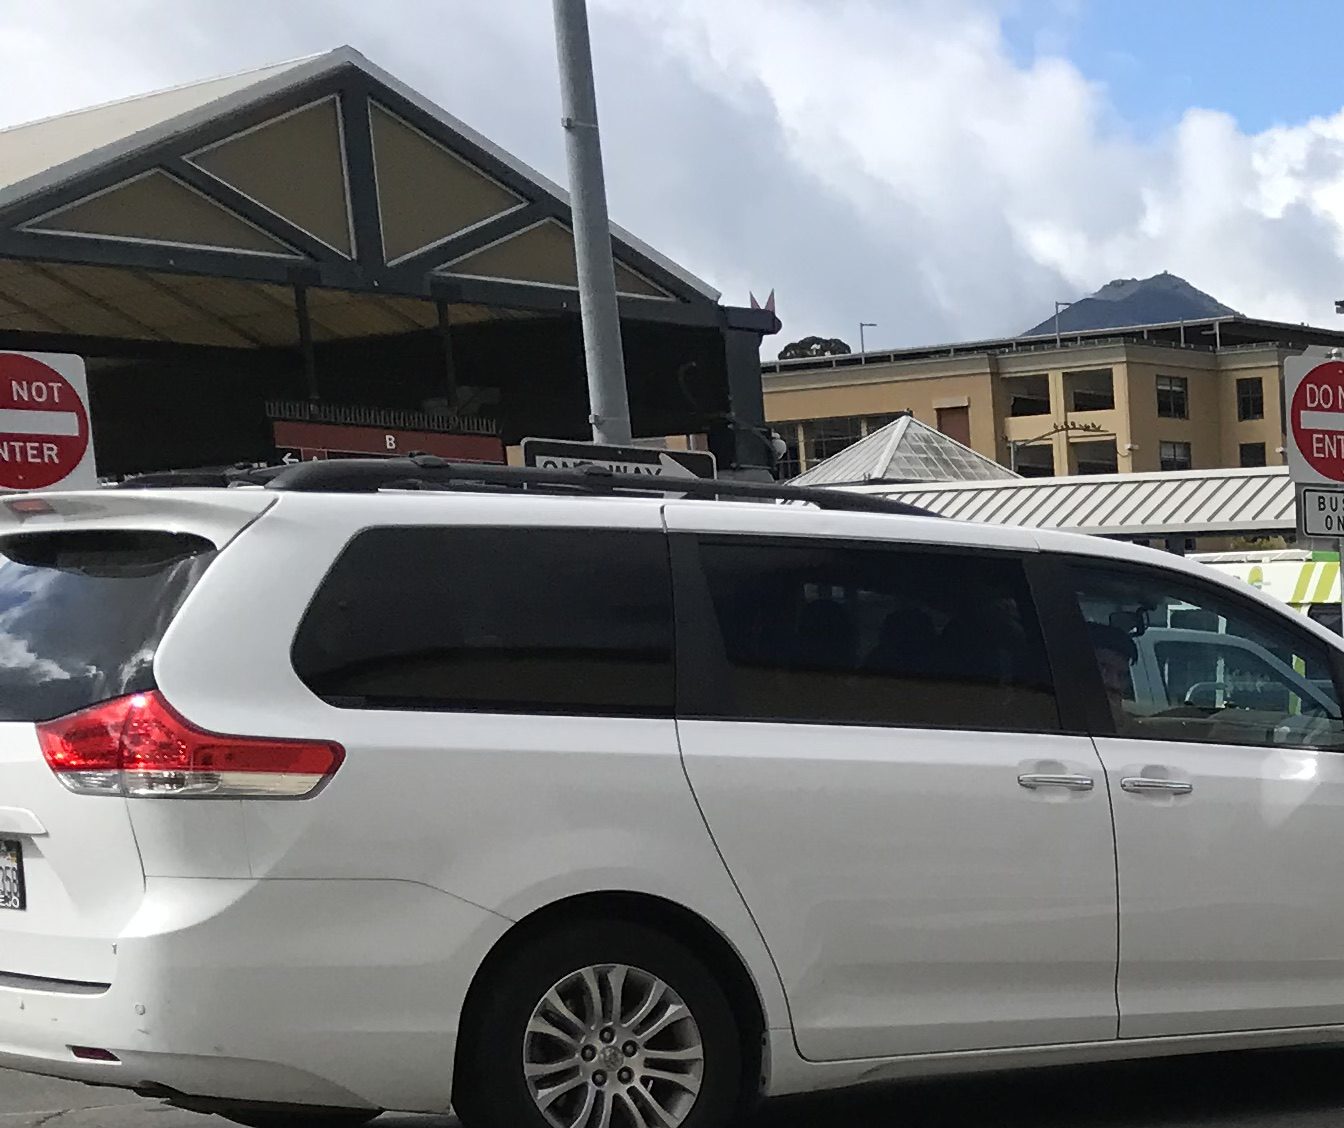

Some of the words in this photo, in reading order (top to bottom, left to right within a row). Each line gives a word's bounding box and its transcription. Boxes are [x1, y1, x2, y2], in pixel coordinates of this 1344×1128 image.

[11, 380, 62, 402] NOT
[1306, 383, 1333, 409] DO
[0, 441, 59, 463] NTER
[385, 434, 396, 449] B
